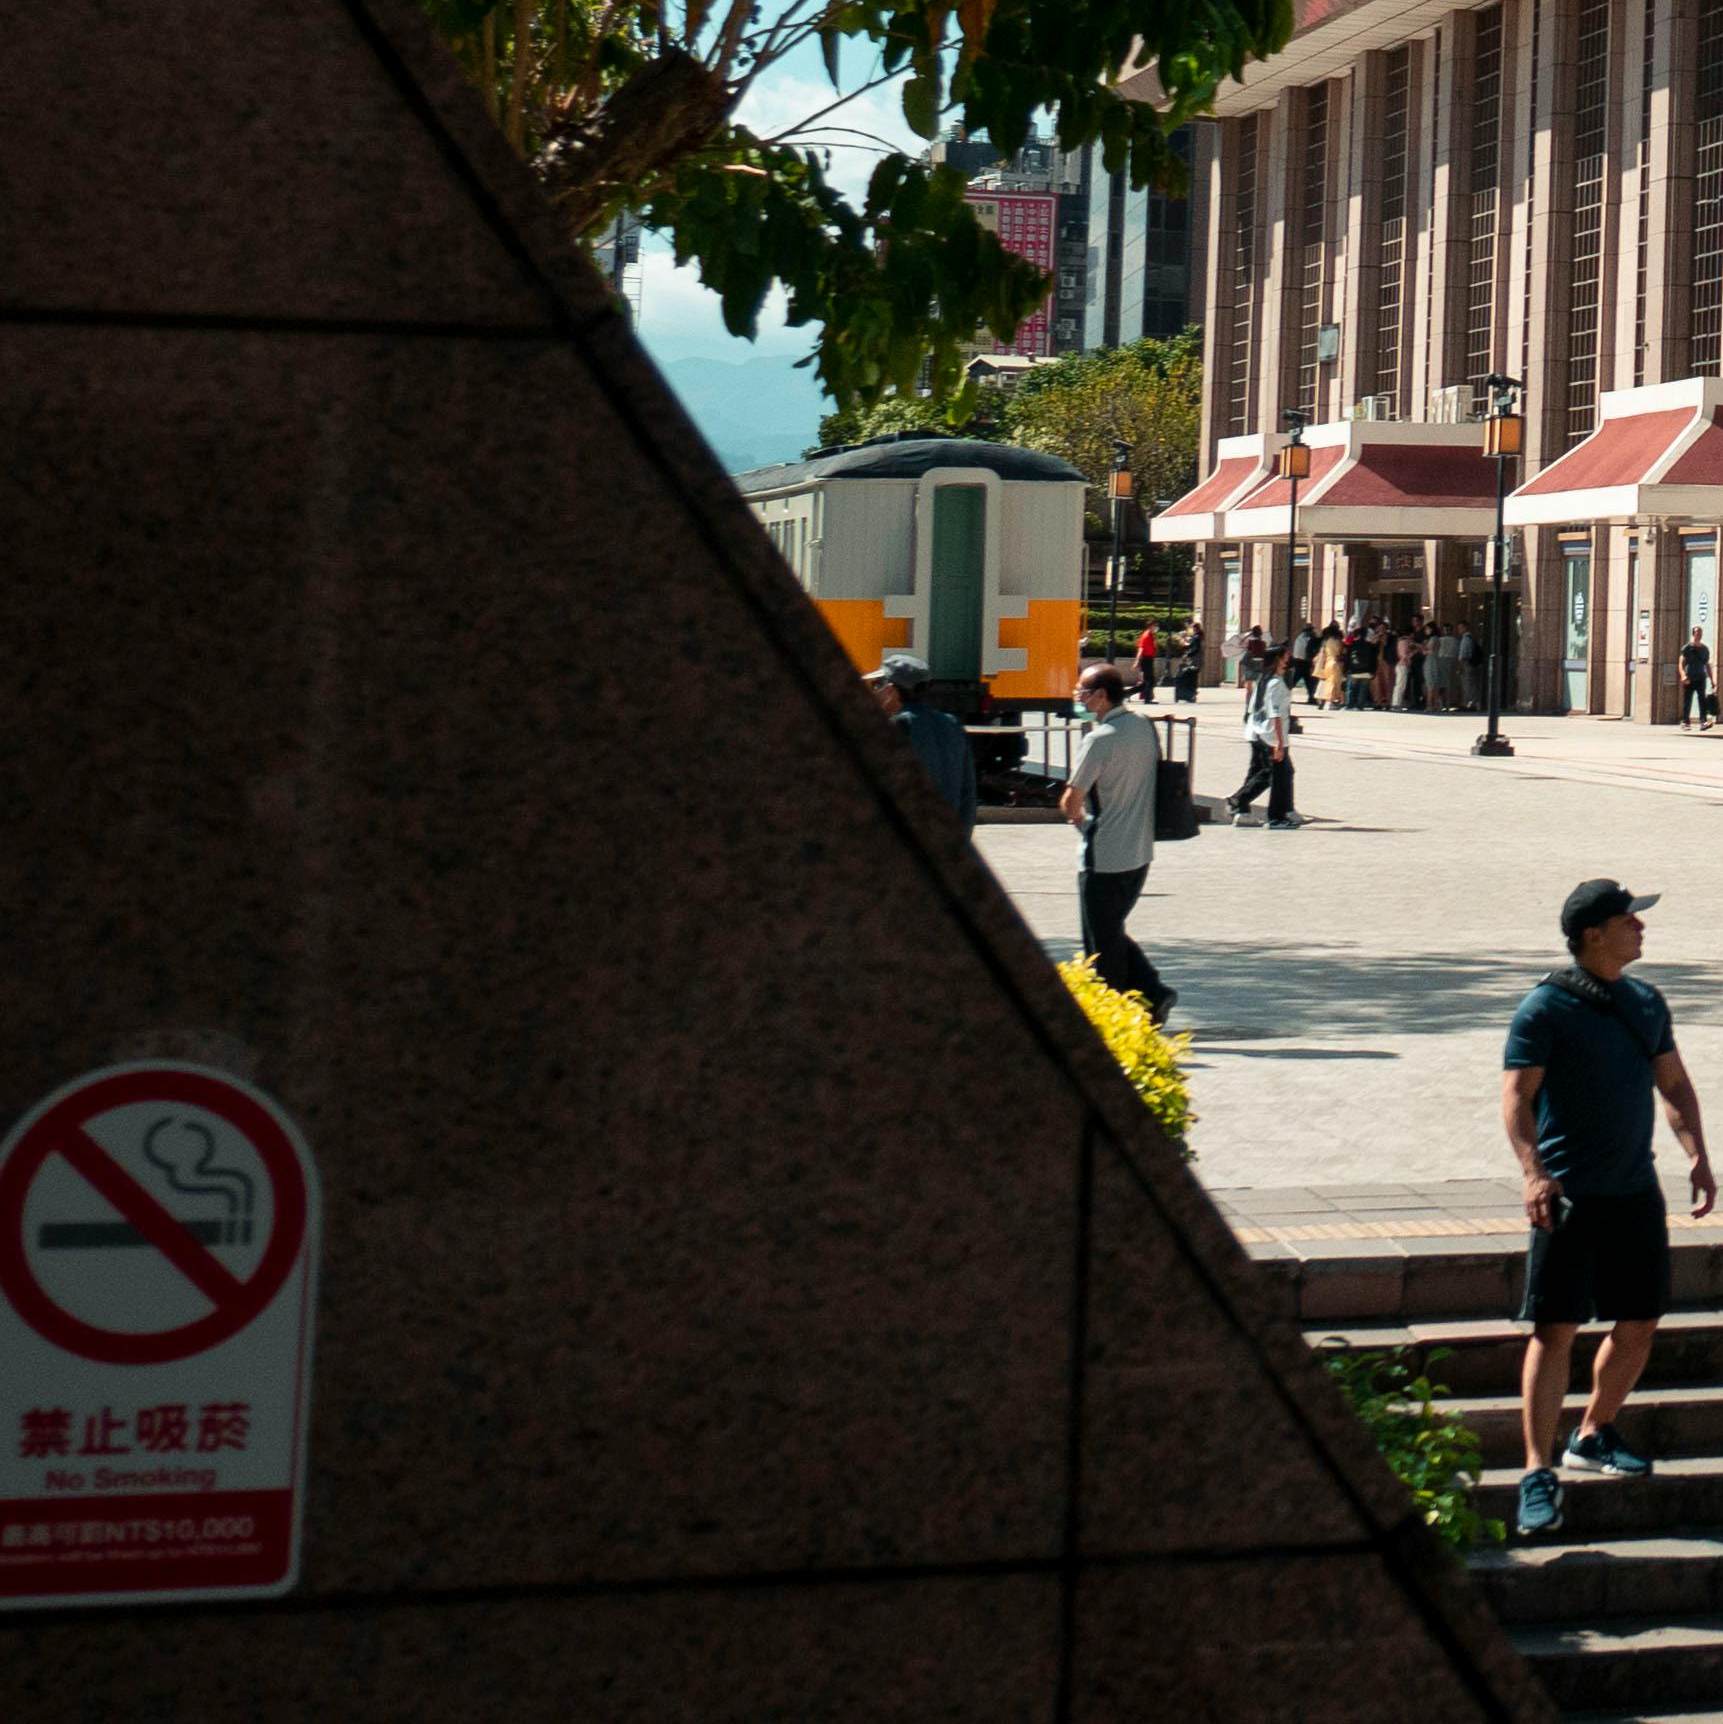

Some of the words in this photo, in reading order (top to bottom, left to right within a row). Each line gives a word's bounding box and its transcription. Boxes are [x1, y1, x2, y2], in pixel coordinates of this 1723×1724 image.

[19, 1401, 252, 1460] 禁止吸菸
[45, 1469, 85, 1491] No
[93, 1466, 217, 1493] Smoking
